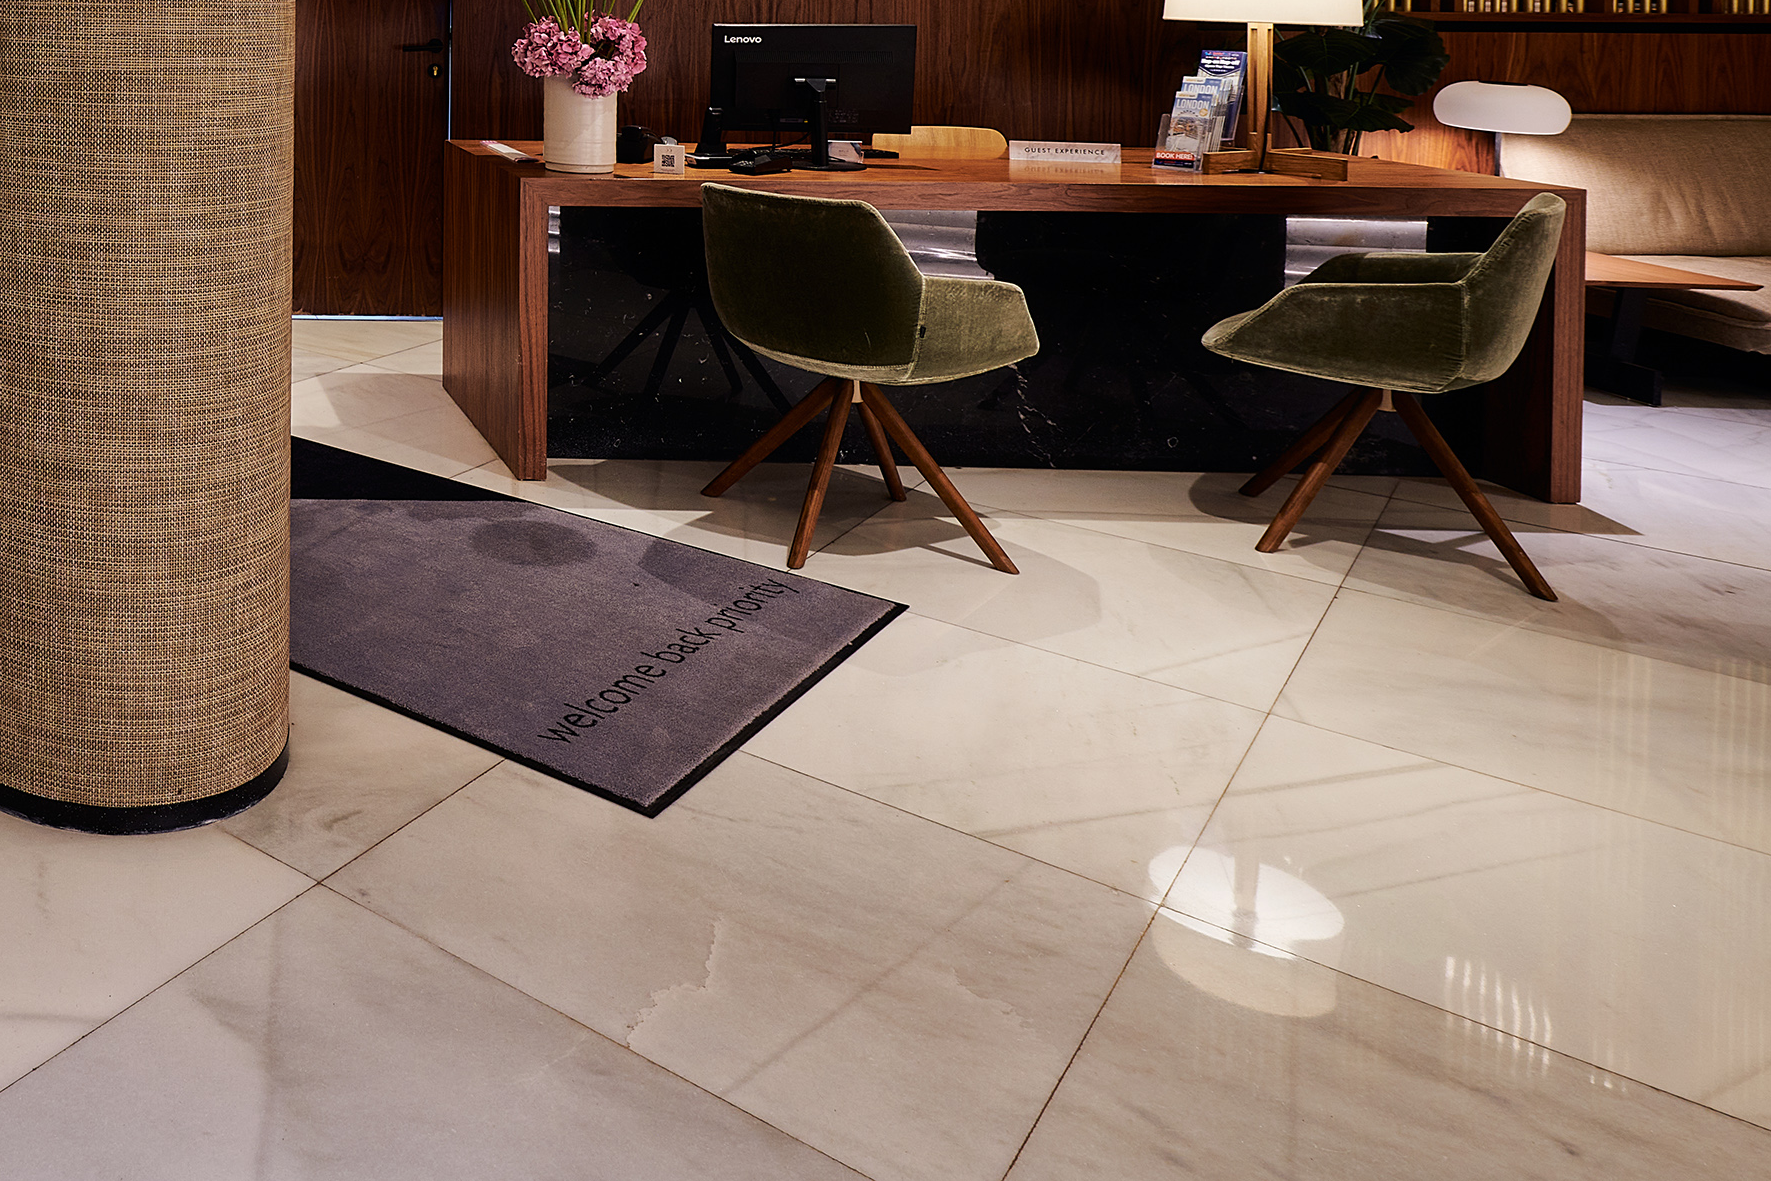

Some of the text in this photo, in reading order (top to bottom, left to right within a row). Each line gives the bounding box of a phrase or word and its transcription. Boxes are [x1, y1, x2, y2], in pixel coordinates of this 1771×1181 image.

[724, 35, 762, 43] Lenovo
[1184, 84, 1218, 94] LONDON
[1176, 99, 1210, 110] LONDON
[537, 579, 800, 743] welcome back priority
